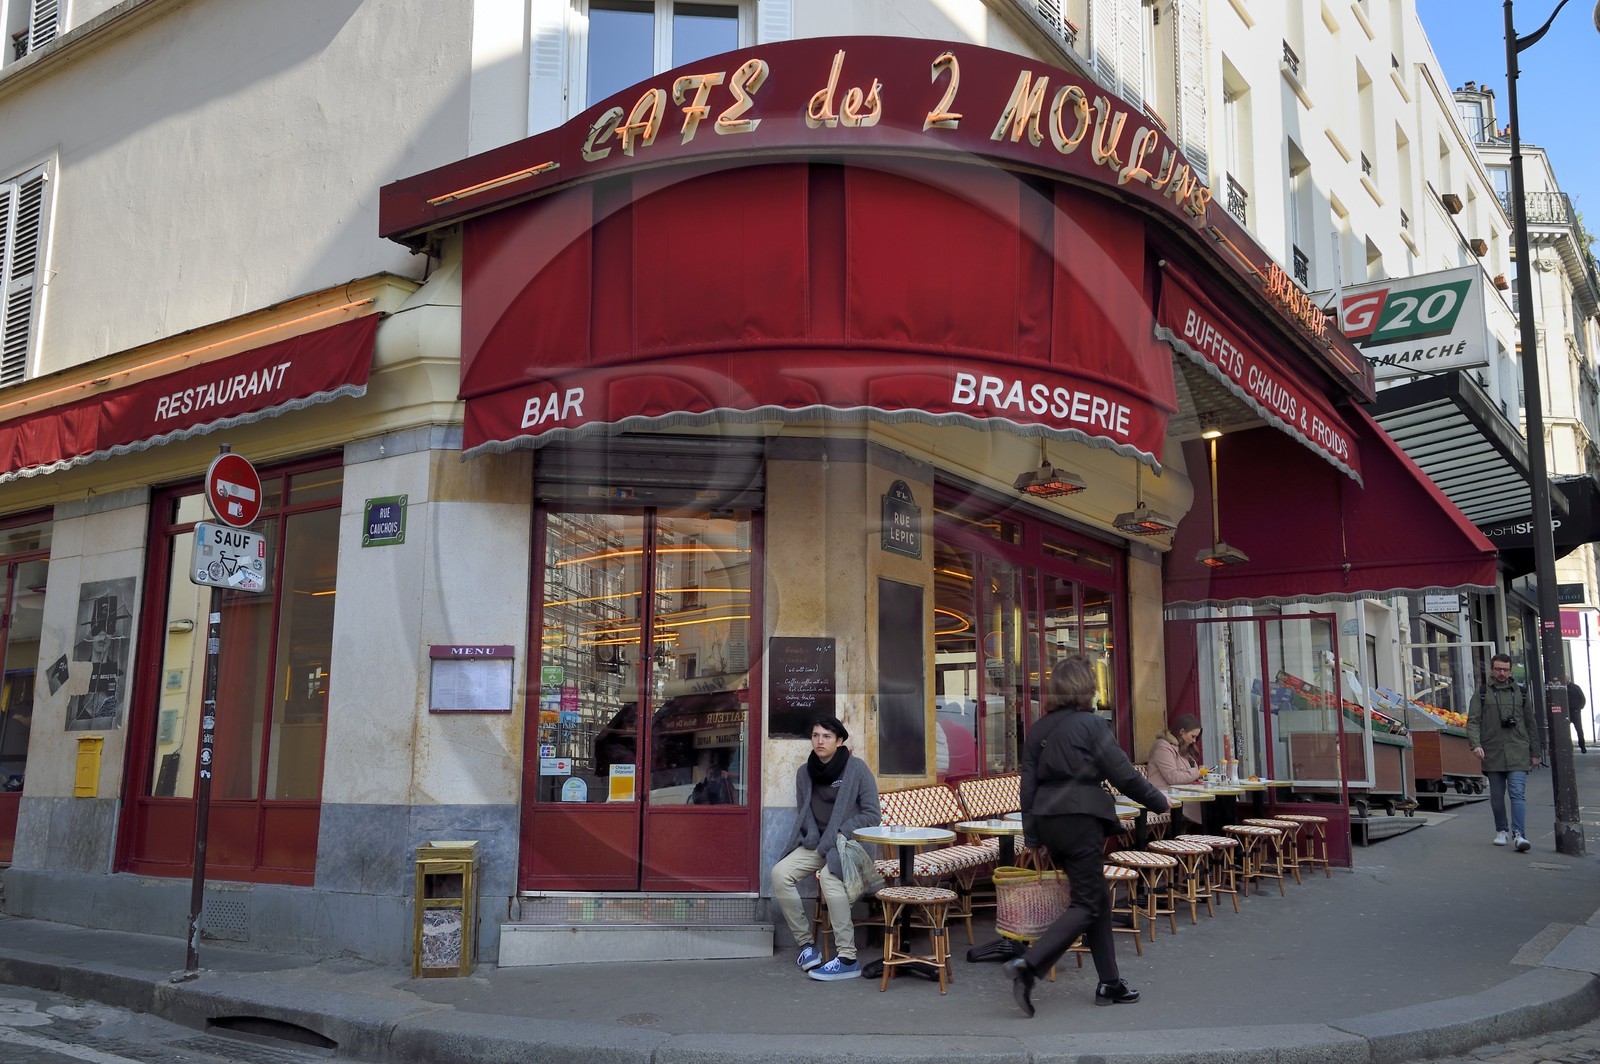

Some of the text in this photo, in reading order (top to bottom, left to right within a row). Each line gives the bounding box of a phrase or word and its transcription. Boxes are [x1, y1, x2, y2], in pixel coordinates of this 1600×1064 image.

[806, 49, 882, 129] des
[923, 51, 963, 131] 2
[990, 69, 1212, 219] MOULINS
[1267, 262, 1329, 341] BRASSERIE
[154, 361, 292, 423] RESTAURANT
[1184, 308, 1350, 460] BUFFETS CHAUDS & FROIDS
[520, 386, 585, 430] BAR
[951, 371, 1132, 437] BRASSERIE
[369, 521, 399, 535] CAUCHOIS
[379, 506, 391, 519] RUE
[894, 511, 911, 528] RUE
[214, 529, 251, 549] SAUF
[890, 526, 915, 546] LEPIC
[450, 647, 496, 655] MENU
